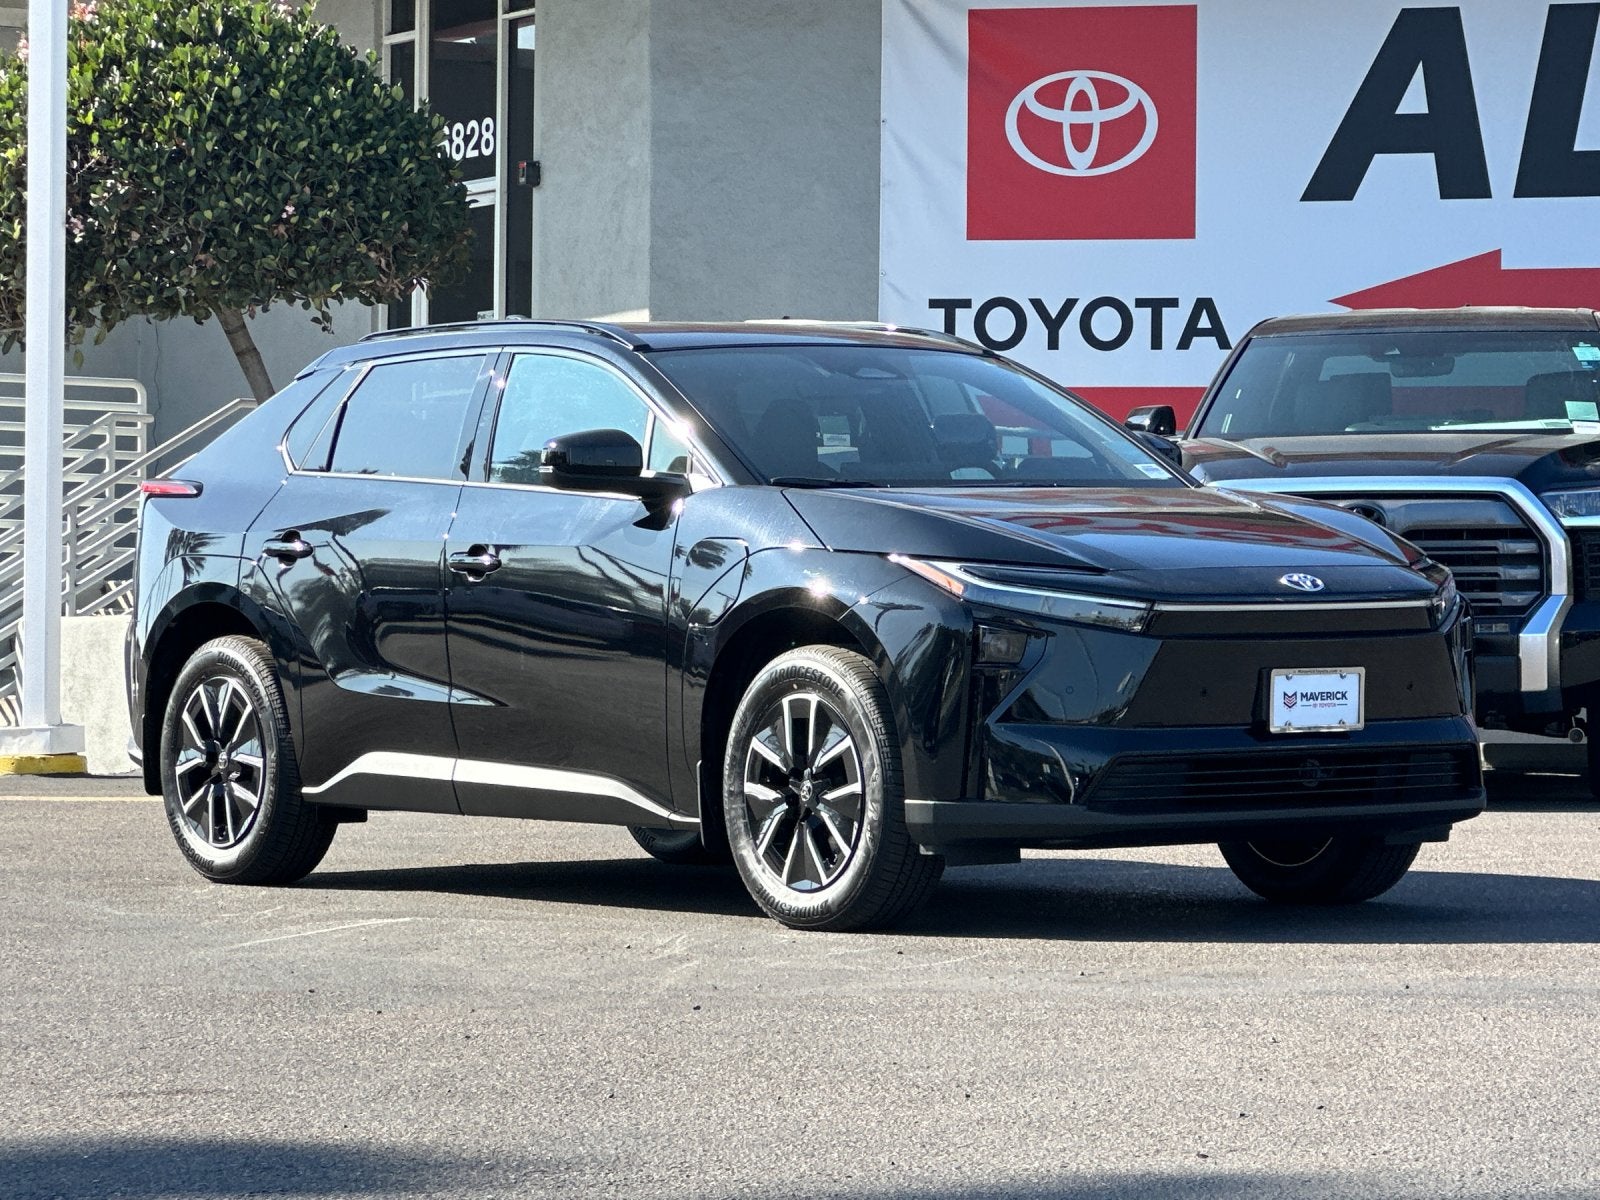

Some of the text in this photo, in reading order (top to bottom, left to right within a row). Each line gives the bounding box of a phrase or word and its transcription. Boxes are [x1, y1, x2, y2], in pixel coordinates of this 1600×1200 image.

[928, 296, 1233, 352] TOYOTA
[769, 665, 846, 700] BRIDGESTONE
[1300, 690, 1348, 702] MAVERICK
[754, 883, 833, 919] BRIDGESTONE
